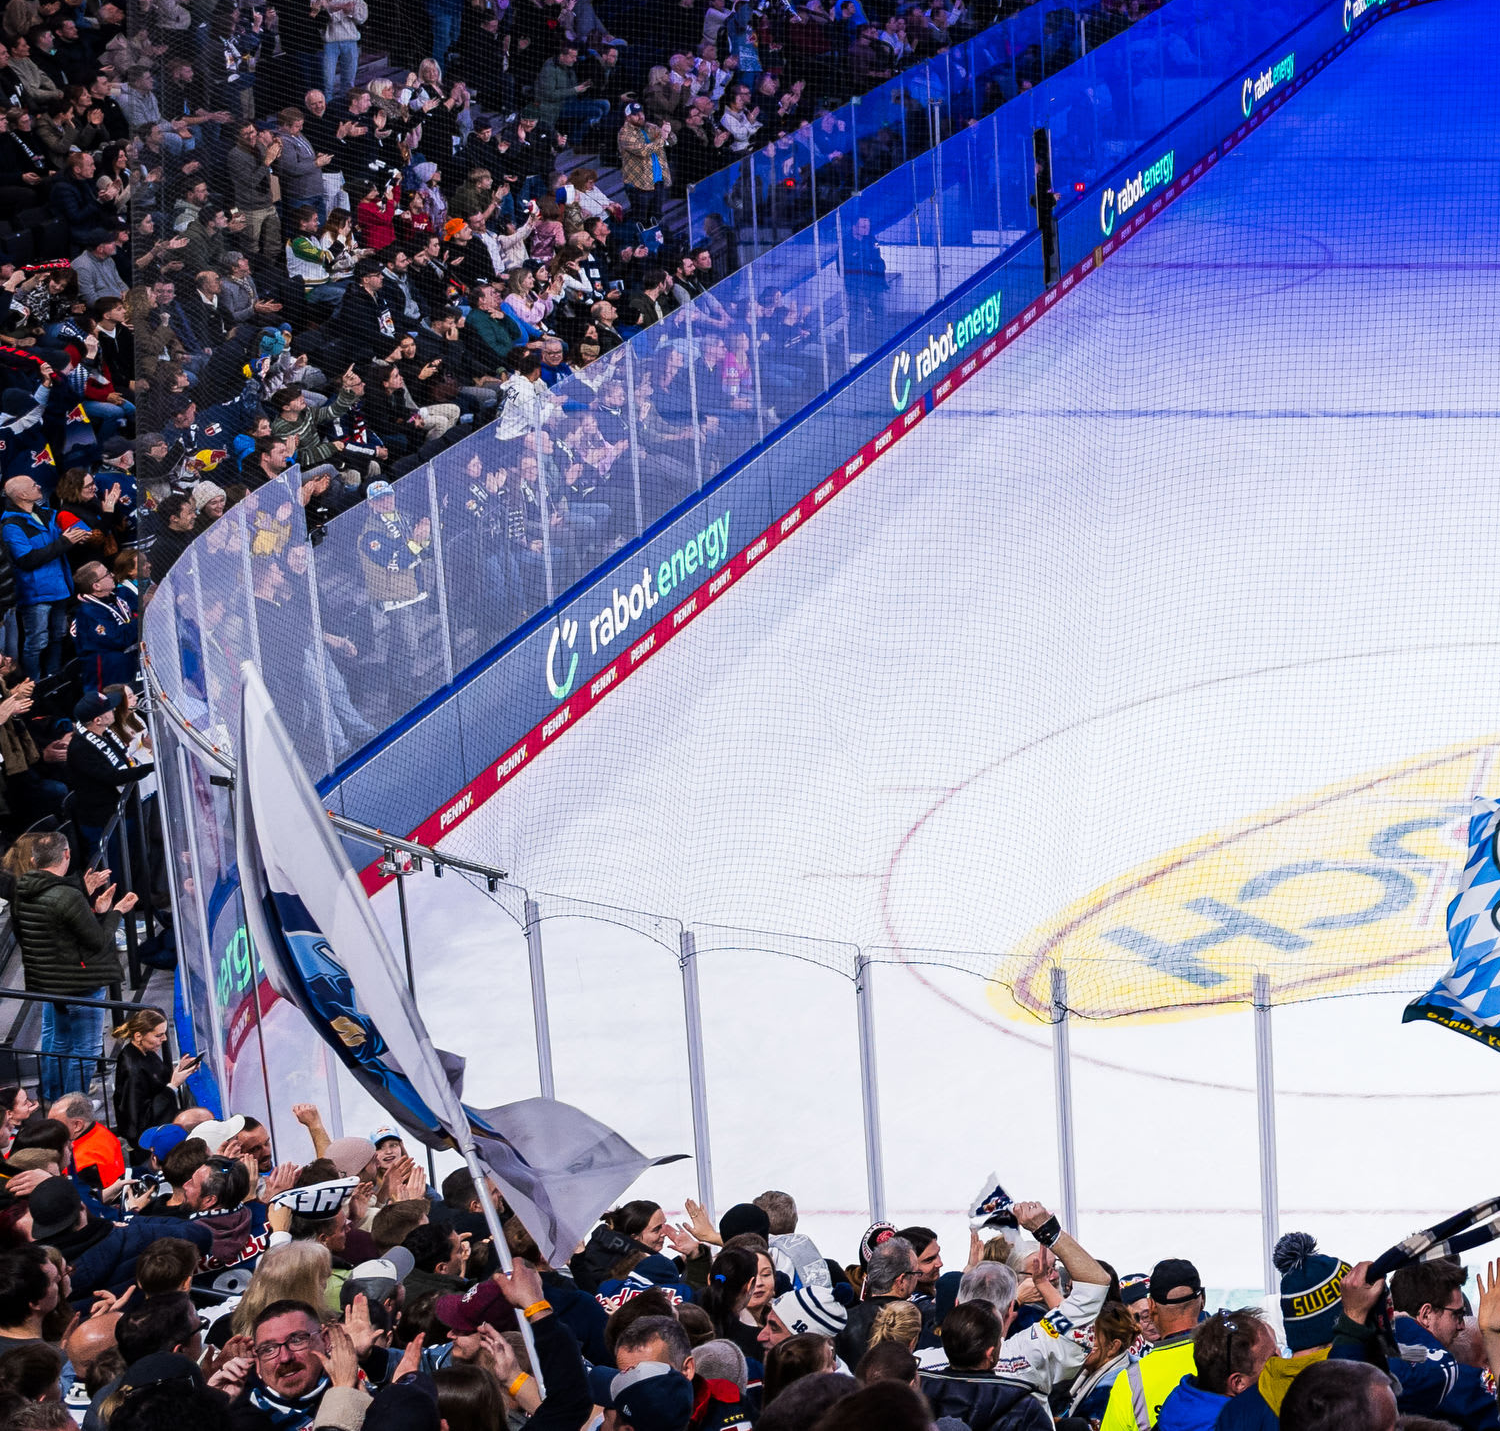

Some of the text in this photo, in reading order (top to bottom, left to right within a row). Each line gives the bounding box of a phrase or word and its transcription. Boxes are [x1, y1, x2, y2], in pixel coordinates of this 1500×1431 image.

[1254, 53, 1295, 102] rabot.energy
[1118, 150, 1174, 215] rabot.energy
[916, 290, 1001, 383] rabot.energy
[589, 509, 731, 655] rabot.energy
